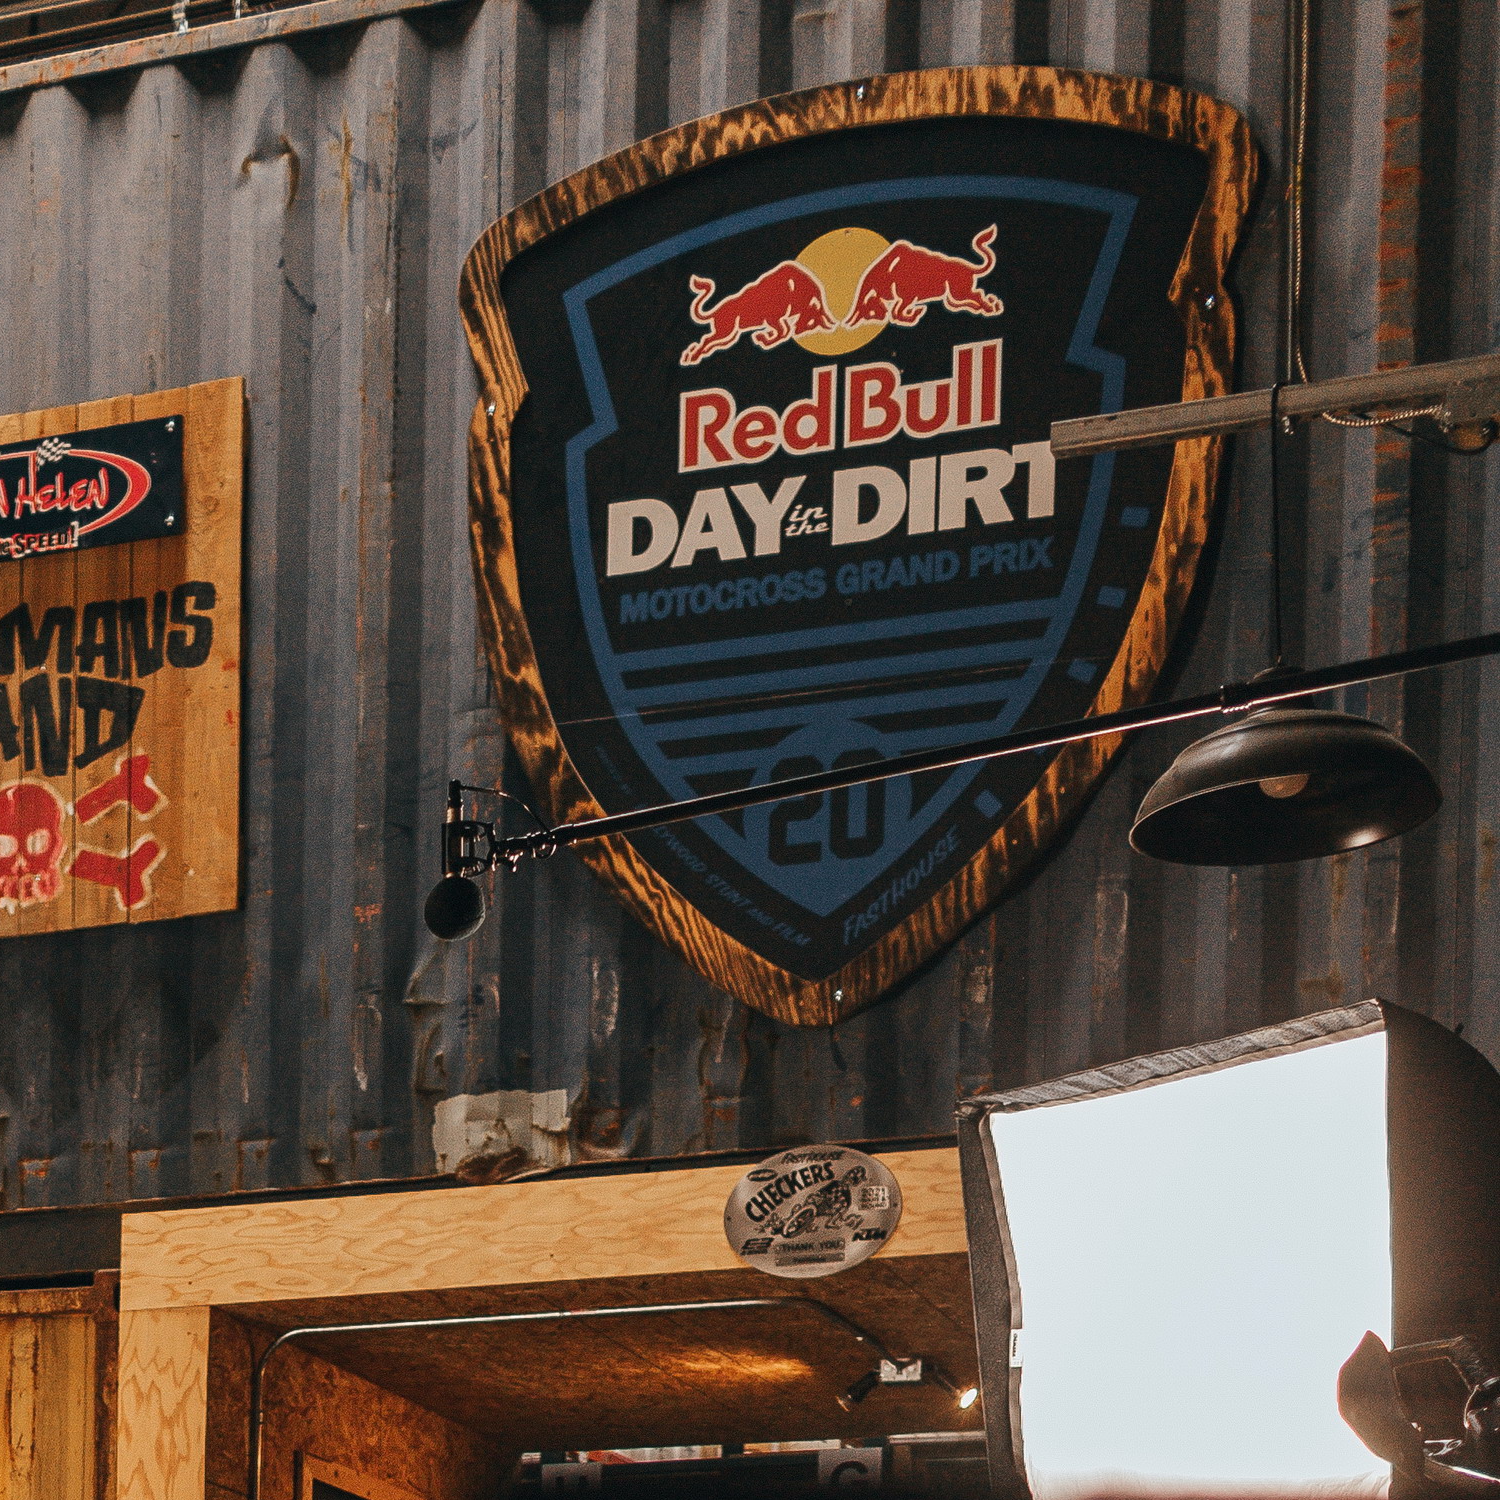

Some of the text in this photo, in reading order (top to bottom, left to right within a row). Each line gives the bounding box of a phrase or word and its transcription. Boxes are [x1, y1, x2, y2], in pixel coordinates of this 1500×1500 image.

[679, 338, 1003, 473] Red Bull
[14, 458, 110, 519] HELEN
[606, 440, 1056, 576] DAY in the DIRT
[620, 535, 1055, 624] MOTOCROSS GRAND PRIX
[768, 748, 886, 866] 20
[842, 824, 962, 946] FASTHOUSE
[745, 1161, 836, 1222] CHECKERS
